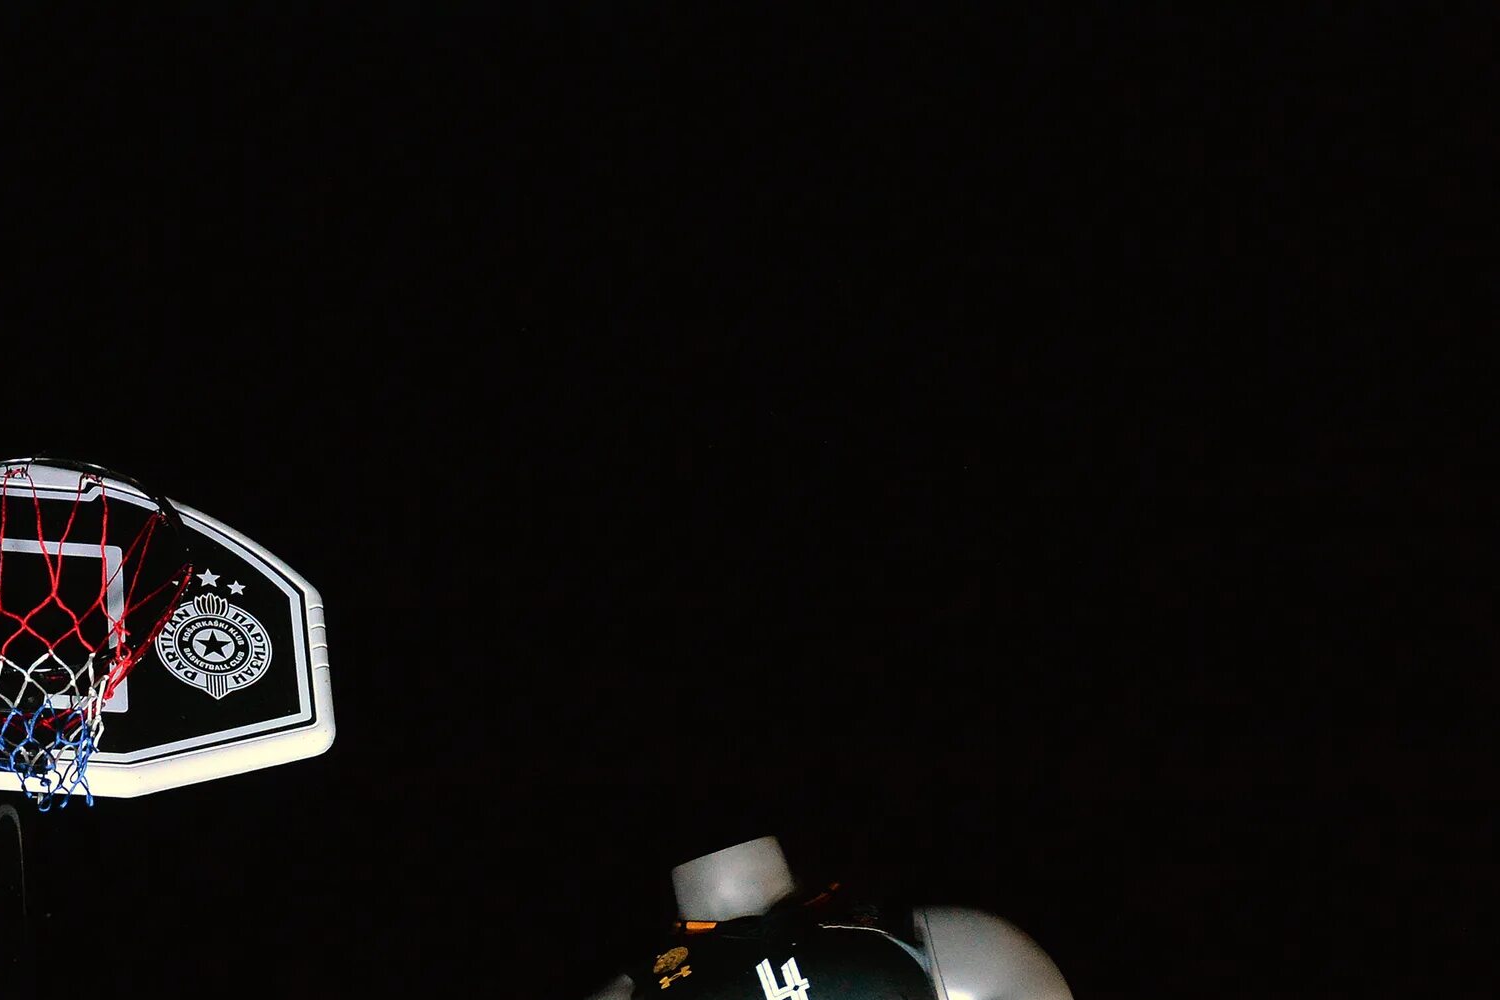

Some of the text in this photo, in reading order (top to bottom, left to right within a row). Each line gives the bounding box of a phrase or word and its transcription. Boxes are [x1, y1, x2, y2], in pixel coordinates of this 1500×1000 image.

[182, 619, 245, 646] KOŠARKAŠKI KLUB
[183, 647, 245, 671] BASKETBALL CLUB
[232, 612, 267, 684] ПАРТИЗАН
